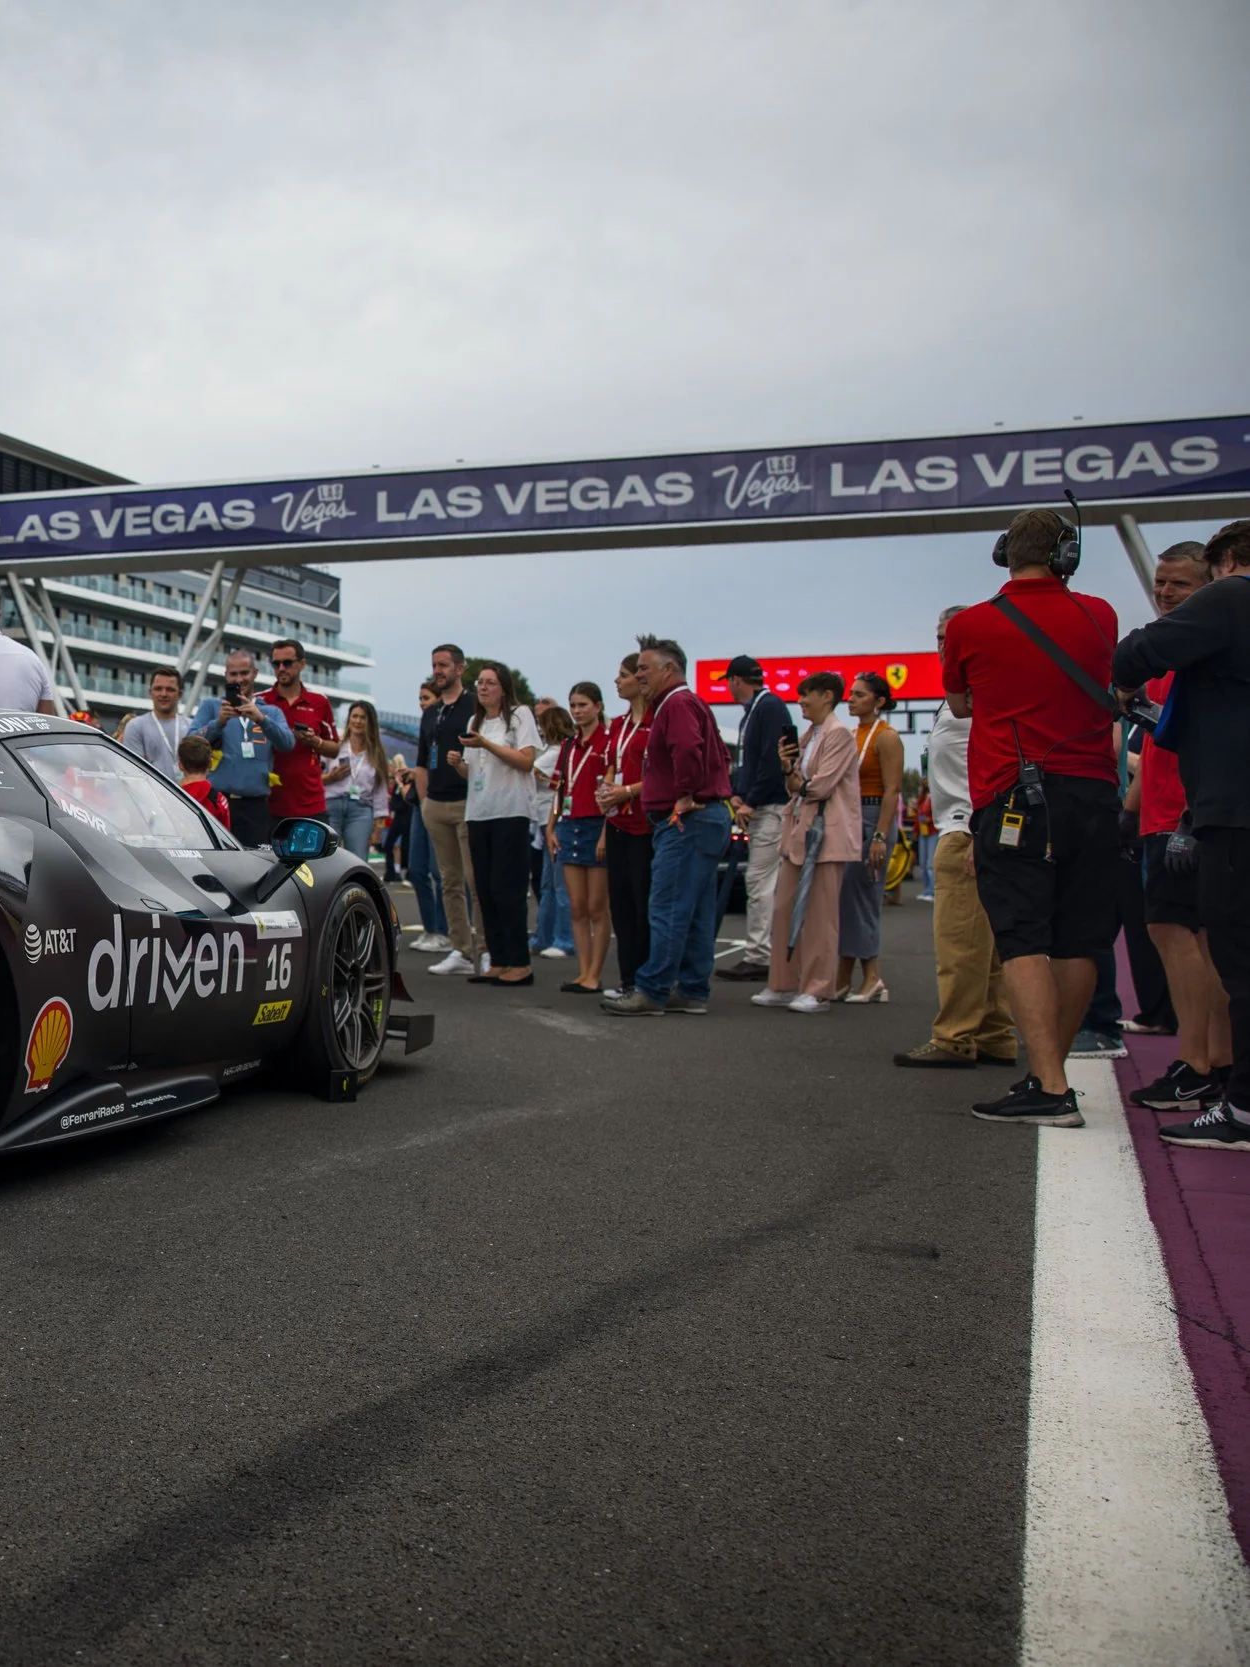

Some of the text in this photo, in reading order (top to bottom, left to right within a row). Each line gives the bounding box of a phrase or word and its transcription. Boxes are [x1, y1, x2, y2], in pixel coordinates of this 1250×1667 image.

[712, 460, 813, 510] Vegas
[767, 456, 795, 474] LAS
[830, 436, 1221, 497] LAS VEGAS
[271, 488, 356, 534] Vegas
[376, 472, 695, 523] LAS VEGAS
[90, 499, 255, 540] VEGAS
[60, 800, 109, 835] MSVR
[44, 928, 77, 955] AT&T
[87, 914, 244, 1011] driven
[265, 943, 291, 991] 16
[258, 1003, 287, 1023] Sabelt
[61, 1103, 125, 1130] @FerrariRaces
